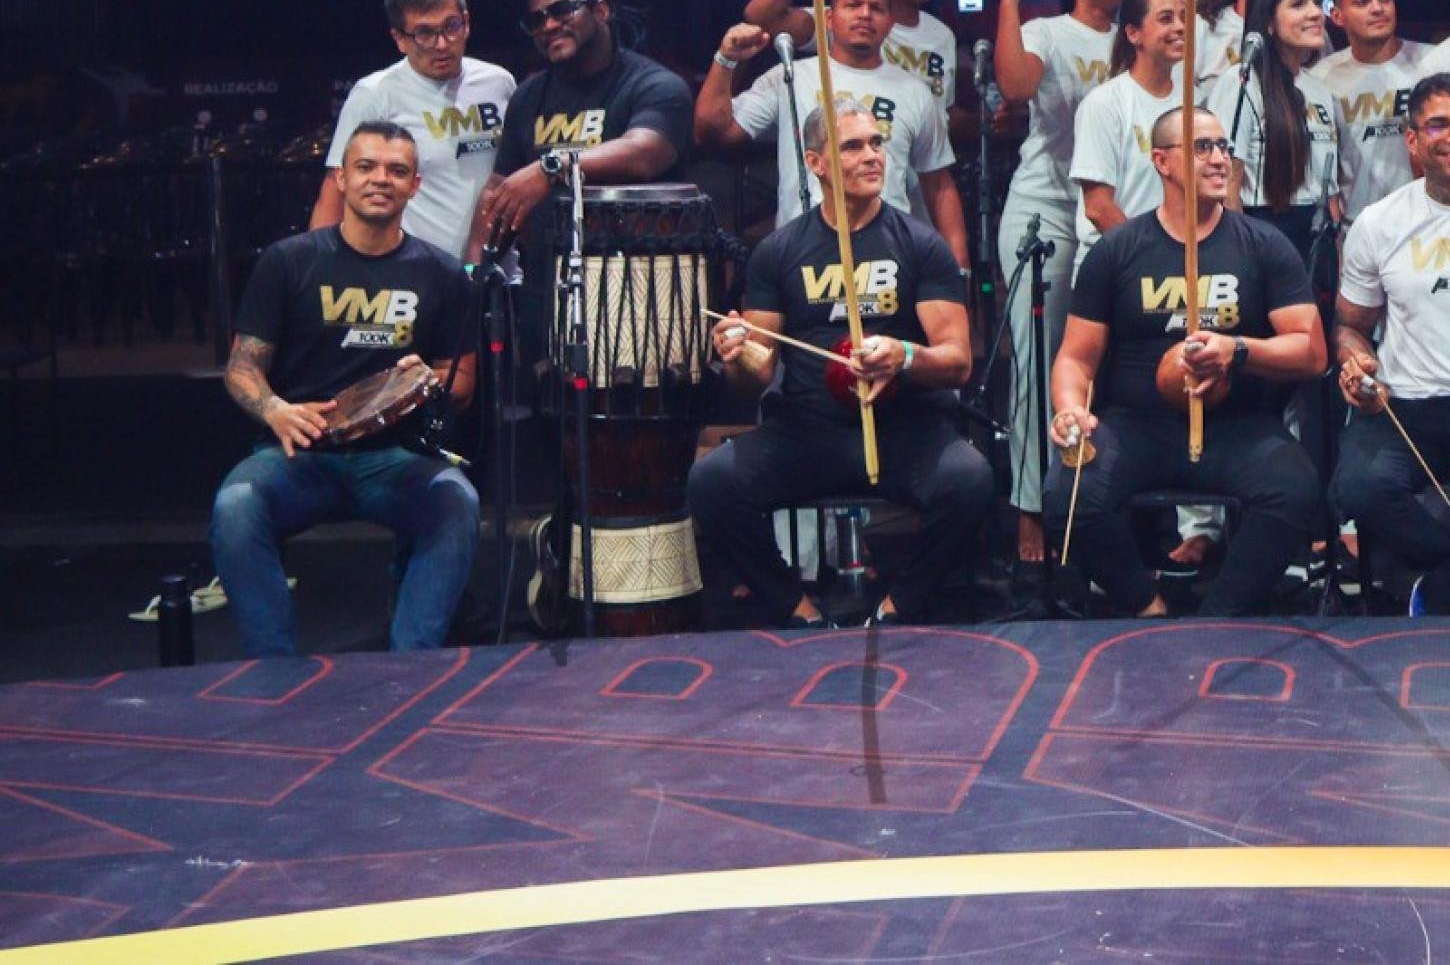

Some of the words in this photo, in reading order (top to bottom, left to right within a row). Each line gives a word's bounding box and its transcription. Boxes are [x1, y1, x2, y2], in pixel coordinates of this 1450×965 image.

[422, 102, 501, 140] VMB
[533, 109, 606, 146] VMB
[801, 260, 898, 299] VMB
[1141, 274, 1239, 311] VMB
[320, 285, 419, 324] VMB
[877, 289, 899, 315] 8
[1217, 302, 1240, 329] 8
